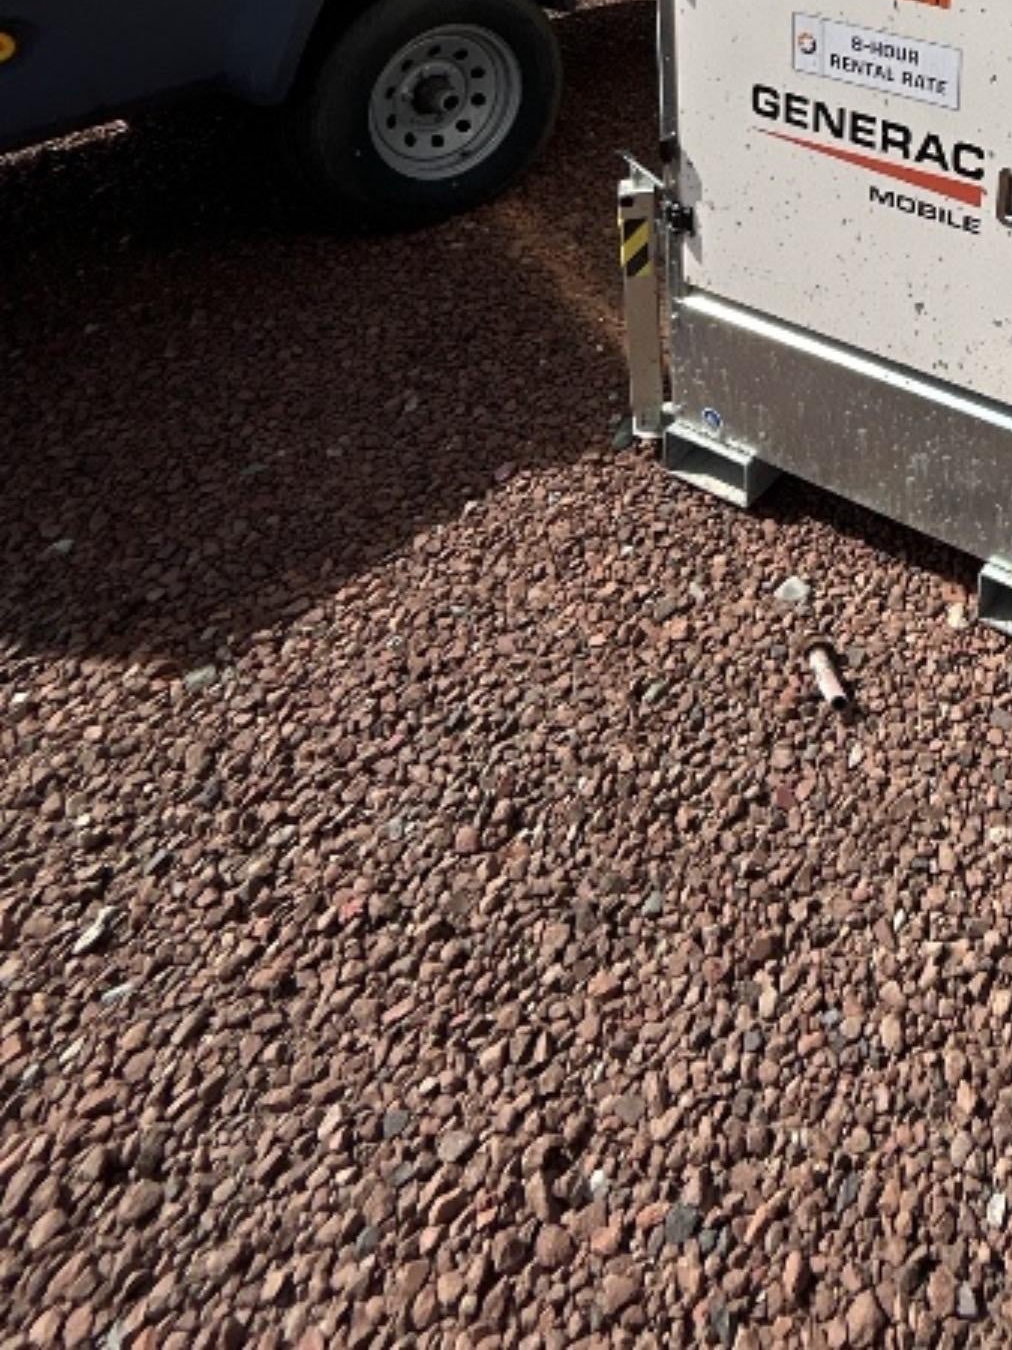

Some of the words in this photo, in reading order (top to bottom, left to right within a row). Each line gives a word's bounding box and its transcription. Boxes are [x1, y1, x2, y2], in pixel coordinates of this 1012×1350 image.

[830, 53, 895, 82] RENTAL
[902, 71, 948, 95] RATE
[851, 36, 919, 66] 8-HOUR
[752, 84, 985, 180] GENERAC
[869, 185, 982, 235] MOBILE
